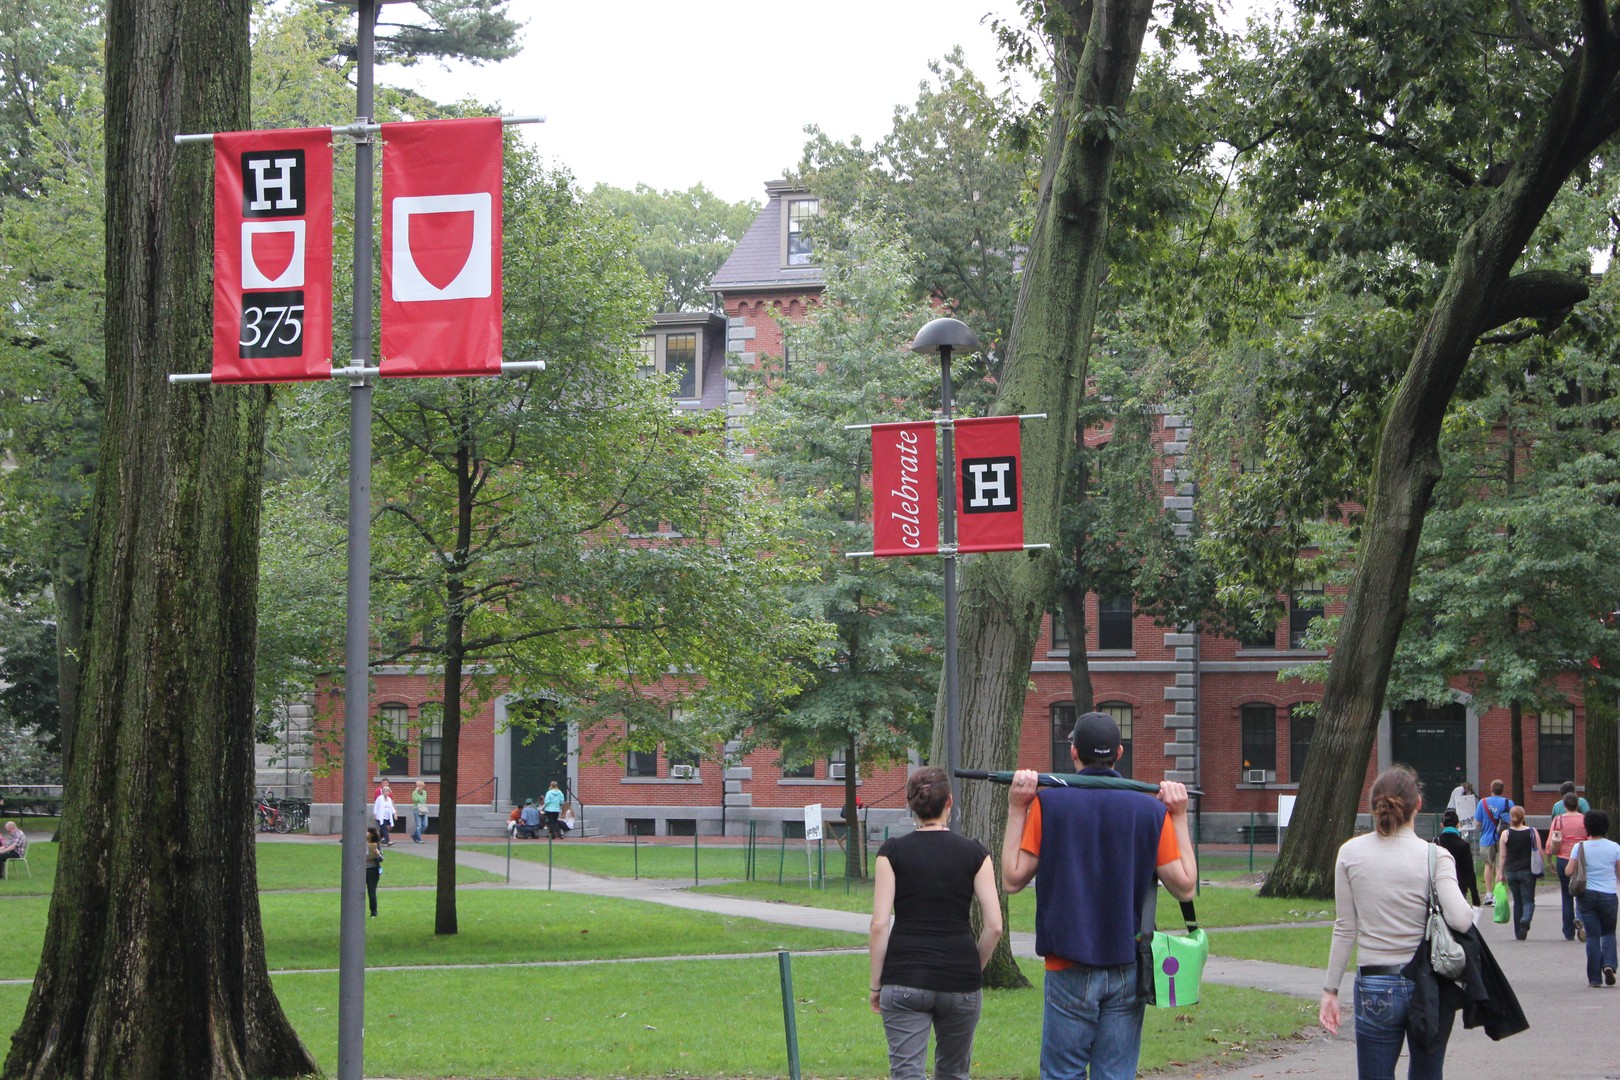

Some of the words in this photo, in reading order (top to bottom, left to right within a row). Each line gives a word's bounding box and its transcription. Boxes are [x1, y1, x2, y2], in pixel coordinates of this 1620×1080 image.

[248, 157, 298, 211] H
[239, 304, 305, 349] 375
[891, 430, 920, 549] celebrate
[968, 462, 1011, 508] H
